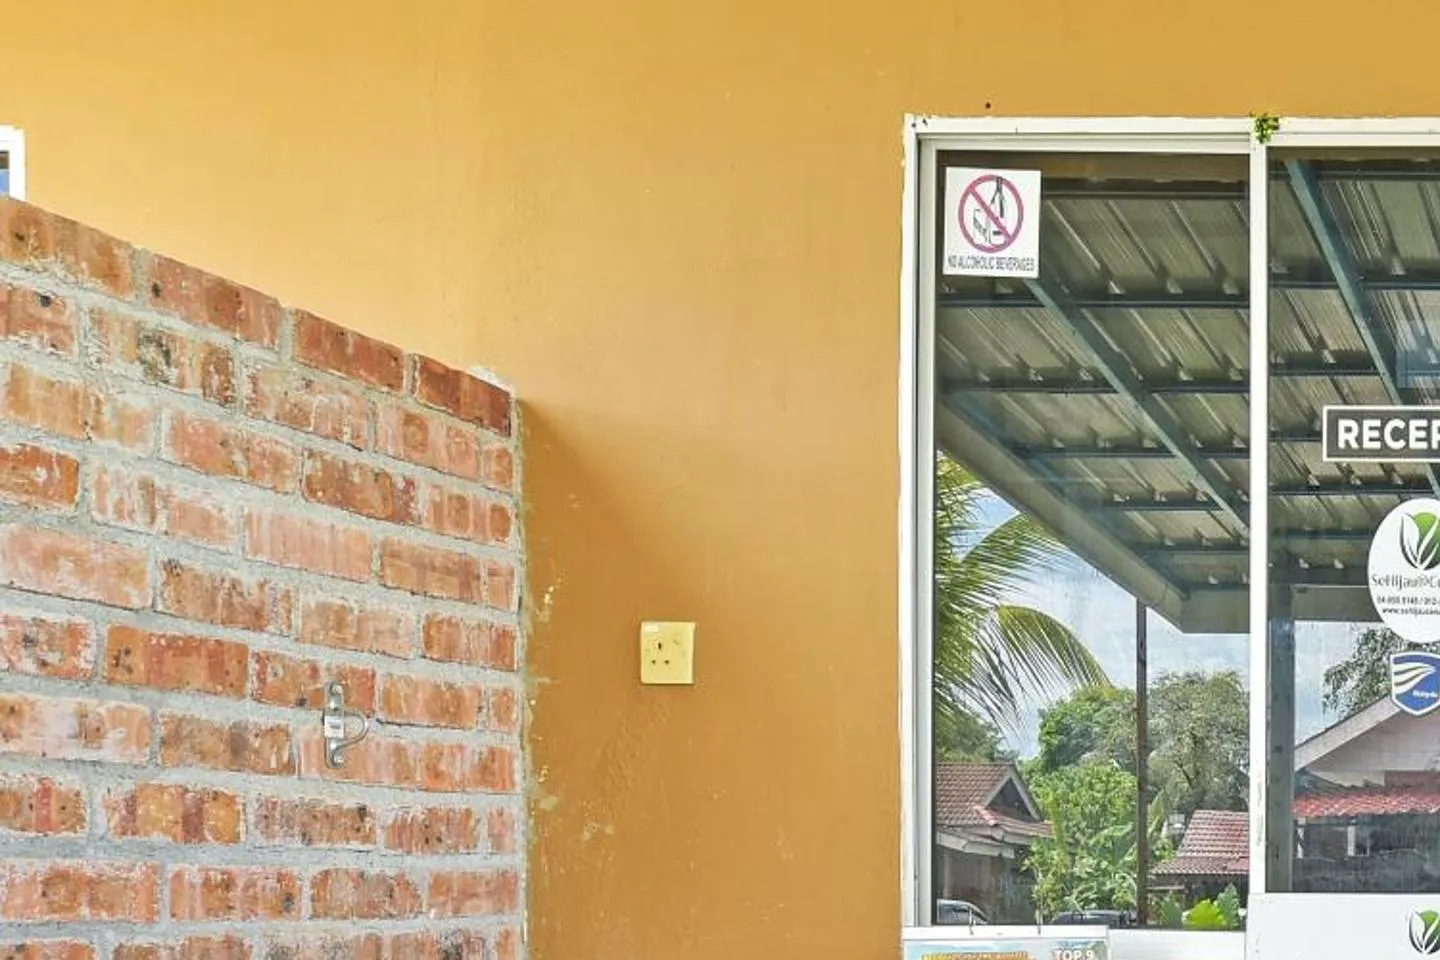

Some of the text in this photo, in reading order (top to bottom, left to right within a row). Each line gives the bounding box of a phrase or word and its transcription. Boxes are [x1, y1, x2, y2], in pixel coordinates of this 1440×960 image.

[947, 255, 1035, 272] NO ALCOHOLIC BEVERAGES
